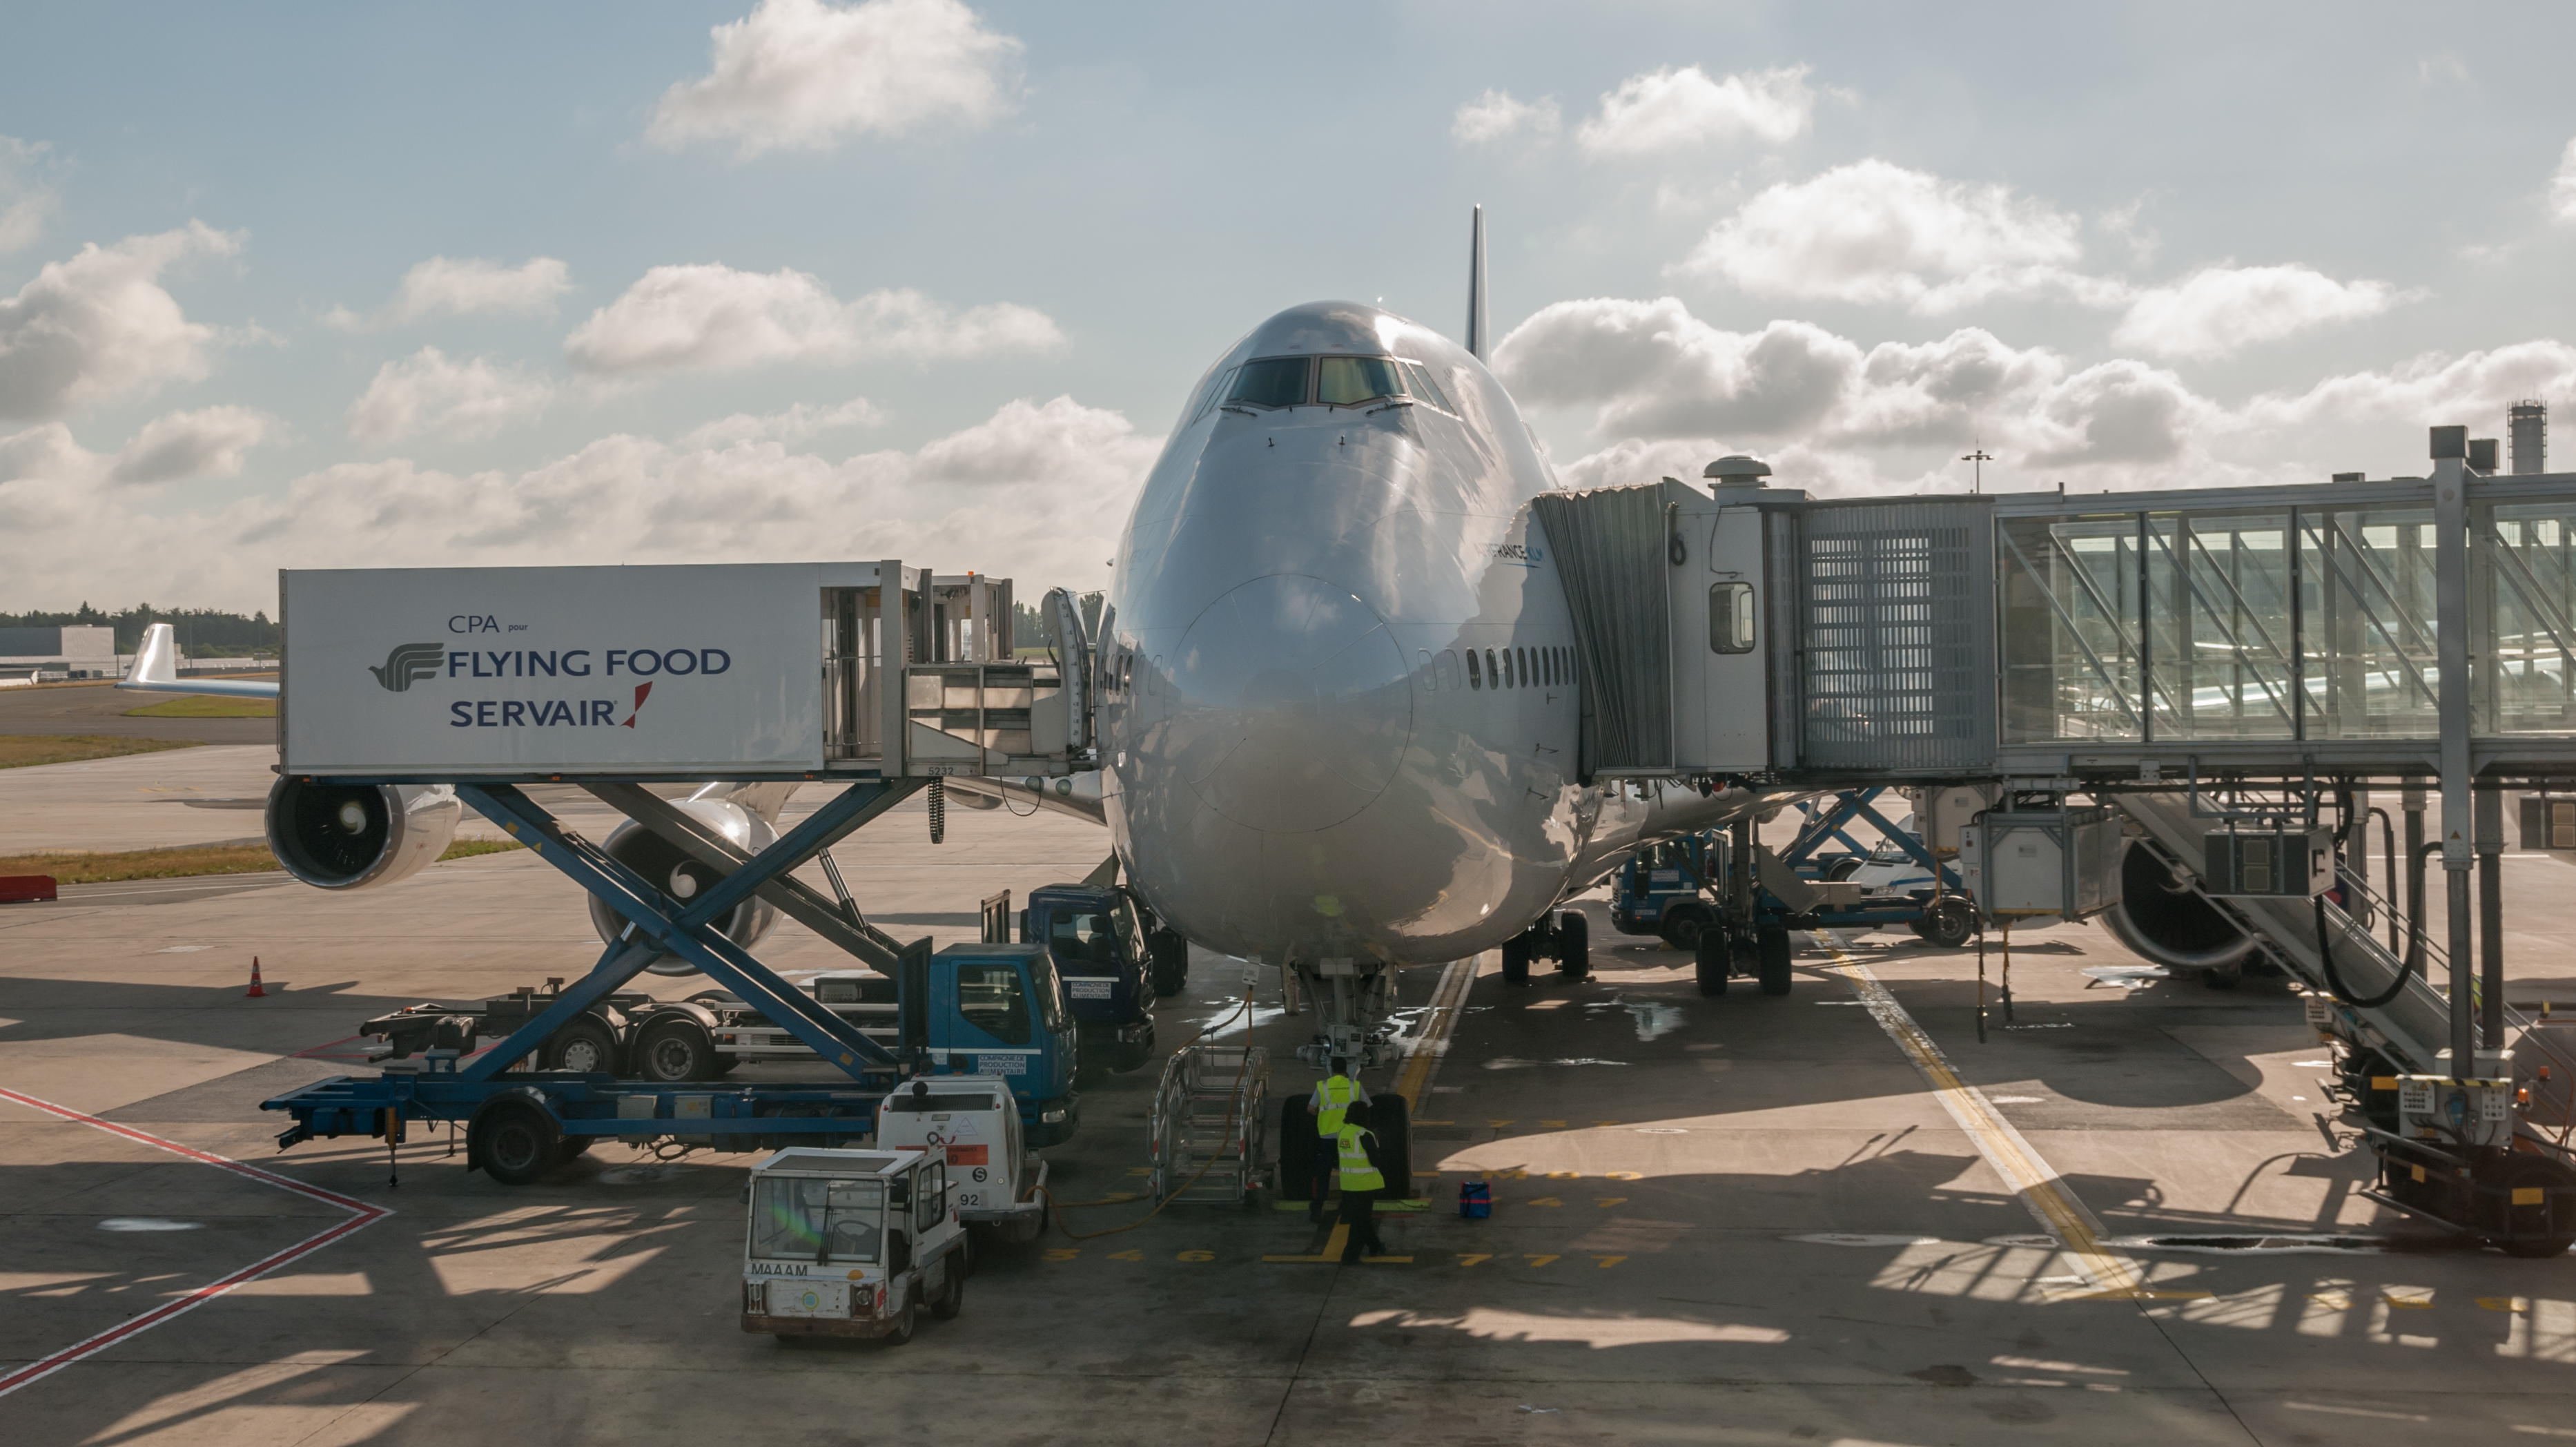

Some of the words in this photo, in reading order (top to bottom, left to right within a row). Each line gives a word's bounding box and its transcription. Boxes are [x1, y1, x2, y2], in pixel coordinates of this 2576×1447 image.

[449, 615, 500, 633] CPA
[508, 624, 528, 632] pour
[449, 650, 591, 677] FLYING
[606, 649, 731, 676] FOOD
[450, 699, 615, 727] SERVAIR
[928, 766, 954, 775] 5232
[751, 1263, 808, 1276] MAAAM
